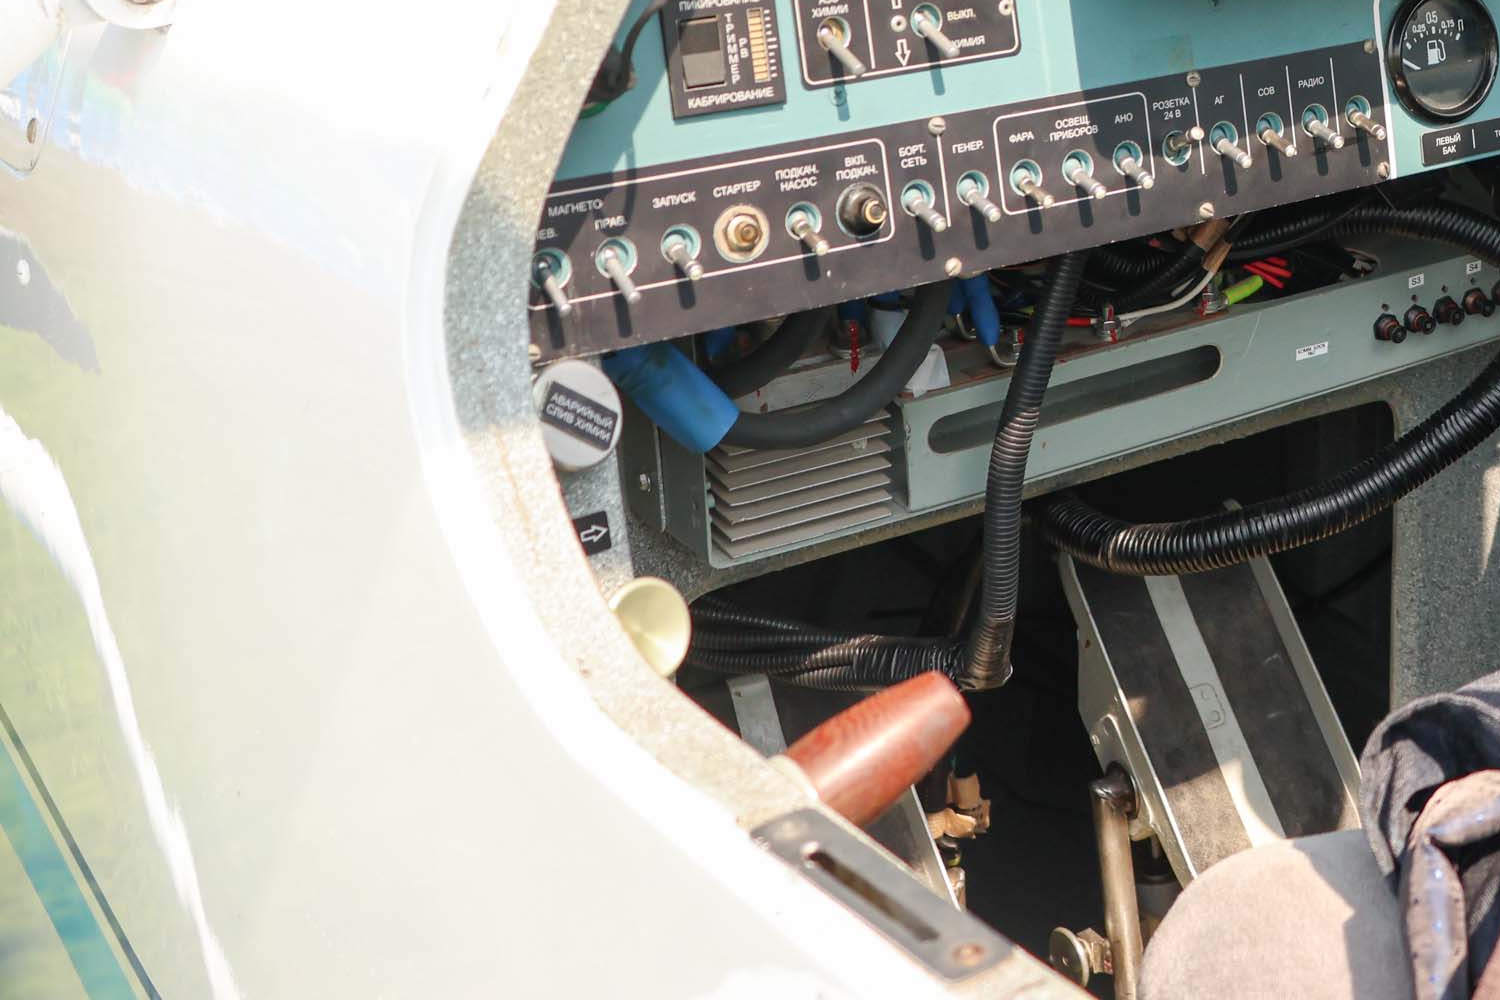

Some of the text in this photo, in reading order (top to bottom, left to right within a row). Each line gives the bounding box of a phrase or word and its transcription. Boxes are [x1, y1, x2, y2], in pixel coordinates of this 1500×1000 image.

[811, 4, 849, 18] ХИМИИ
[946, 8, 976, 21] ВЫКЛ.
[724, 13, 741, 84] ТРИММЕР
[1297, 74, 1325, 88] РАДИО
[688, 87, 775, 109] КАБРИРОВАНИЕ
[1256, 85, 1275, 97] СОВ
[1152, 95, 1190, 111] РОЗЕТКА
[1214, 94, 1225, 106] АГ
[1114, 111, 1133, 124] АНО
[1163, 109, 1174, 120] 24
[1055, 116, 1090, 130] ОСВЕЩ.
[1009, 130, 1034, 144] ФАРА
[1049, 125, 1099, 143] ПРИБОРОВ
[1435, 132, 1461, 147] ЛЕВЫЙ
[898, 144, 927, 158] БОРТ.
[952, 139, 984, 154] ГЕНЕР.
[1442, 143, 1457, 156] БАК
[844, 155, 867, 167] ВКЛ.
[901, 155, 928, 169] СЕТЬ
[774, 164, 819, 181] ПОДКАЧ.
[835, 164, 879, 181] ПОДКАЧ.
[713, 180, 761, 198] СТАРТЕР
[780, 176, 818, 191] НАСОС
[652, 192, 696, 209] ЗАПУСК
[548, 199, 603, 217] МАГНЕТО
[594, 216, 627, 231] ПРАВ.
[1468, 263, 1478, 272] S4
[1411, 276, 1421, 286] S3
[550, 392, 614, 429] АВАРИЙНЫЙ
[546, 403, 611, 441] СЛИВ ХИМИИ
